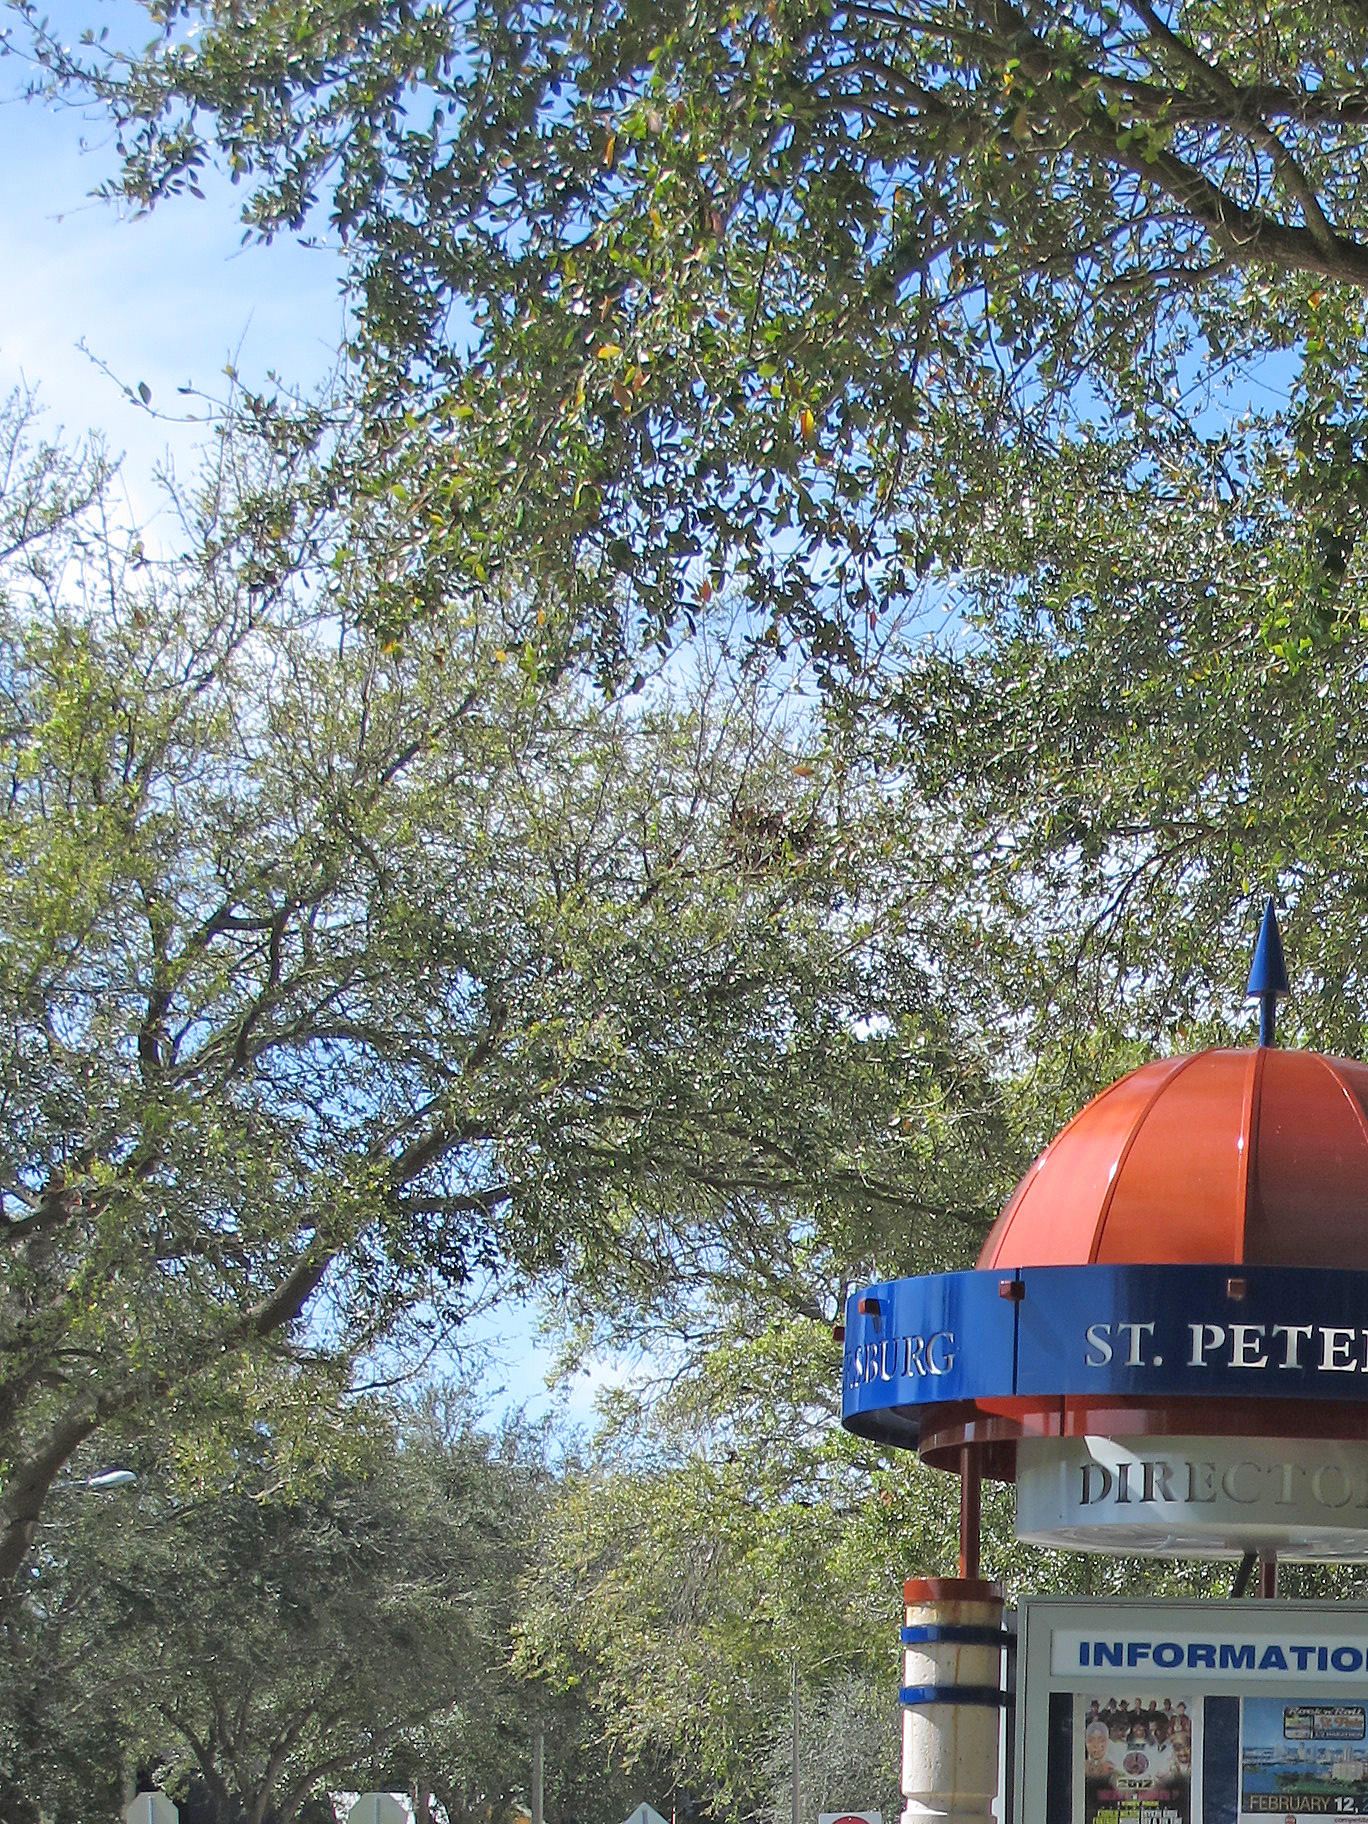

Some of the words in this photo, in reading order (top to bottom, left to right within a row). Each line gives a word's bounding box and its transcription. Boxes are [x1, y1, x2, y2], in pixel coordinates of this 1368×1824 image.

[1084, 1322, 1163, 1368] ST.
[1249, 1796, 1330, 1811] FEBRUARY
[1334, 1796, 1359, 1815] 12,
